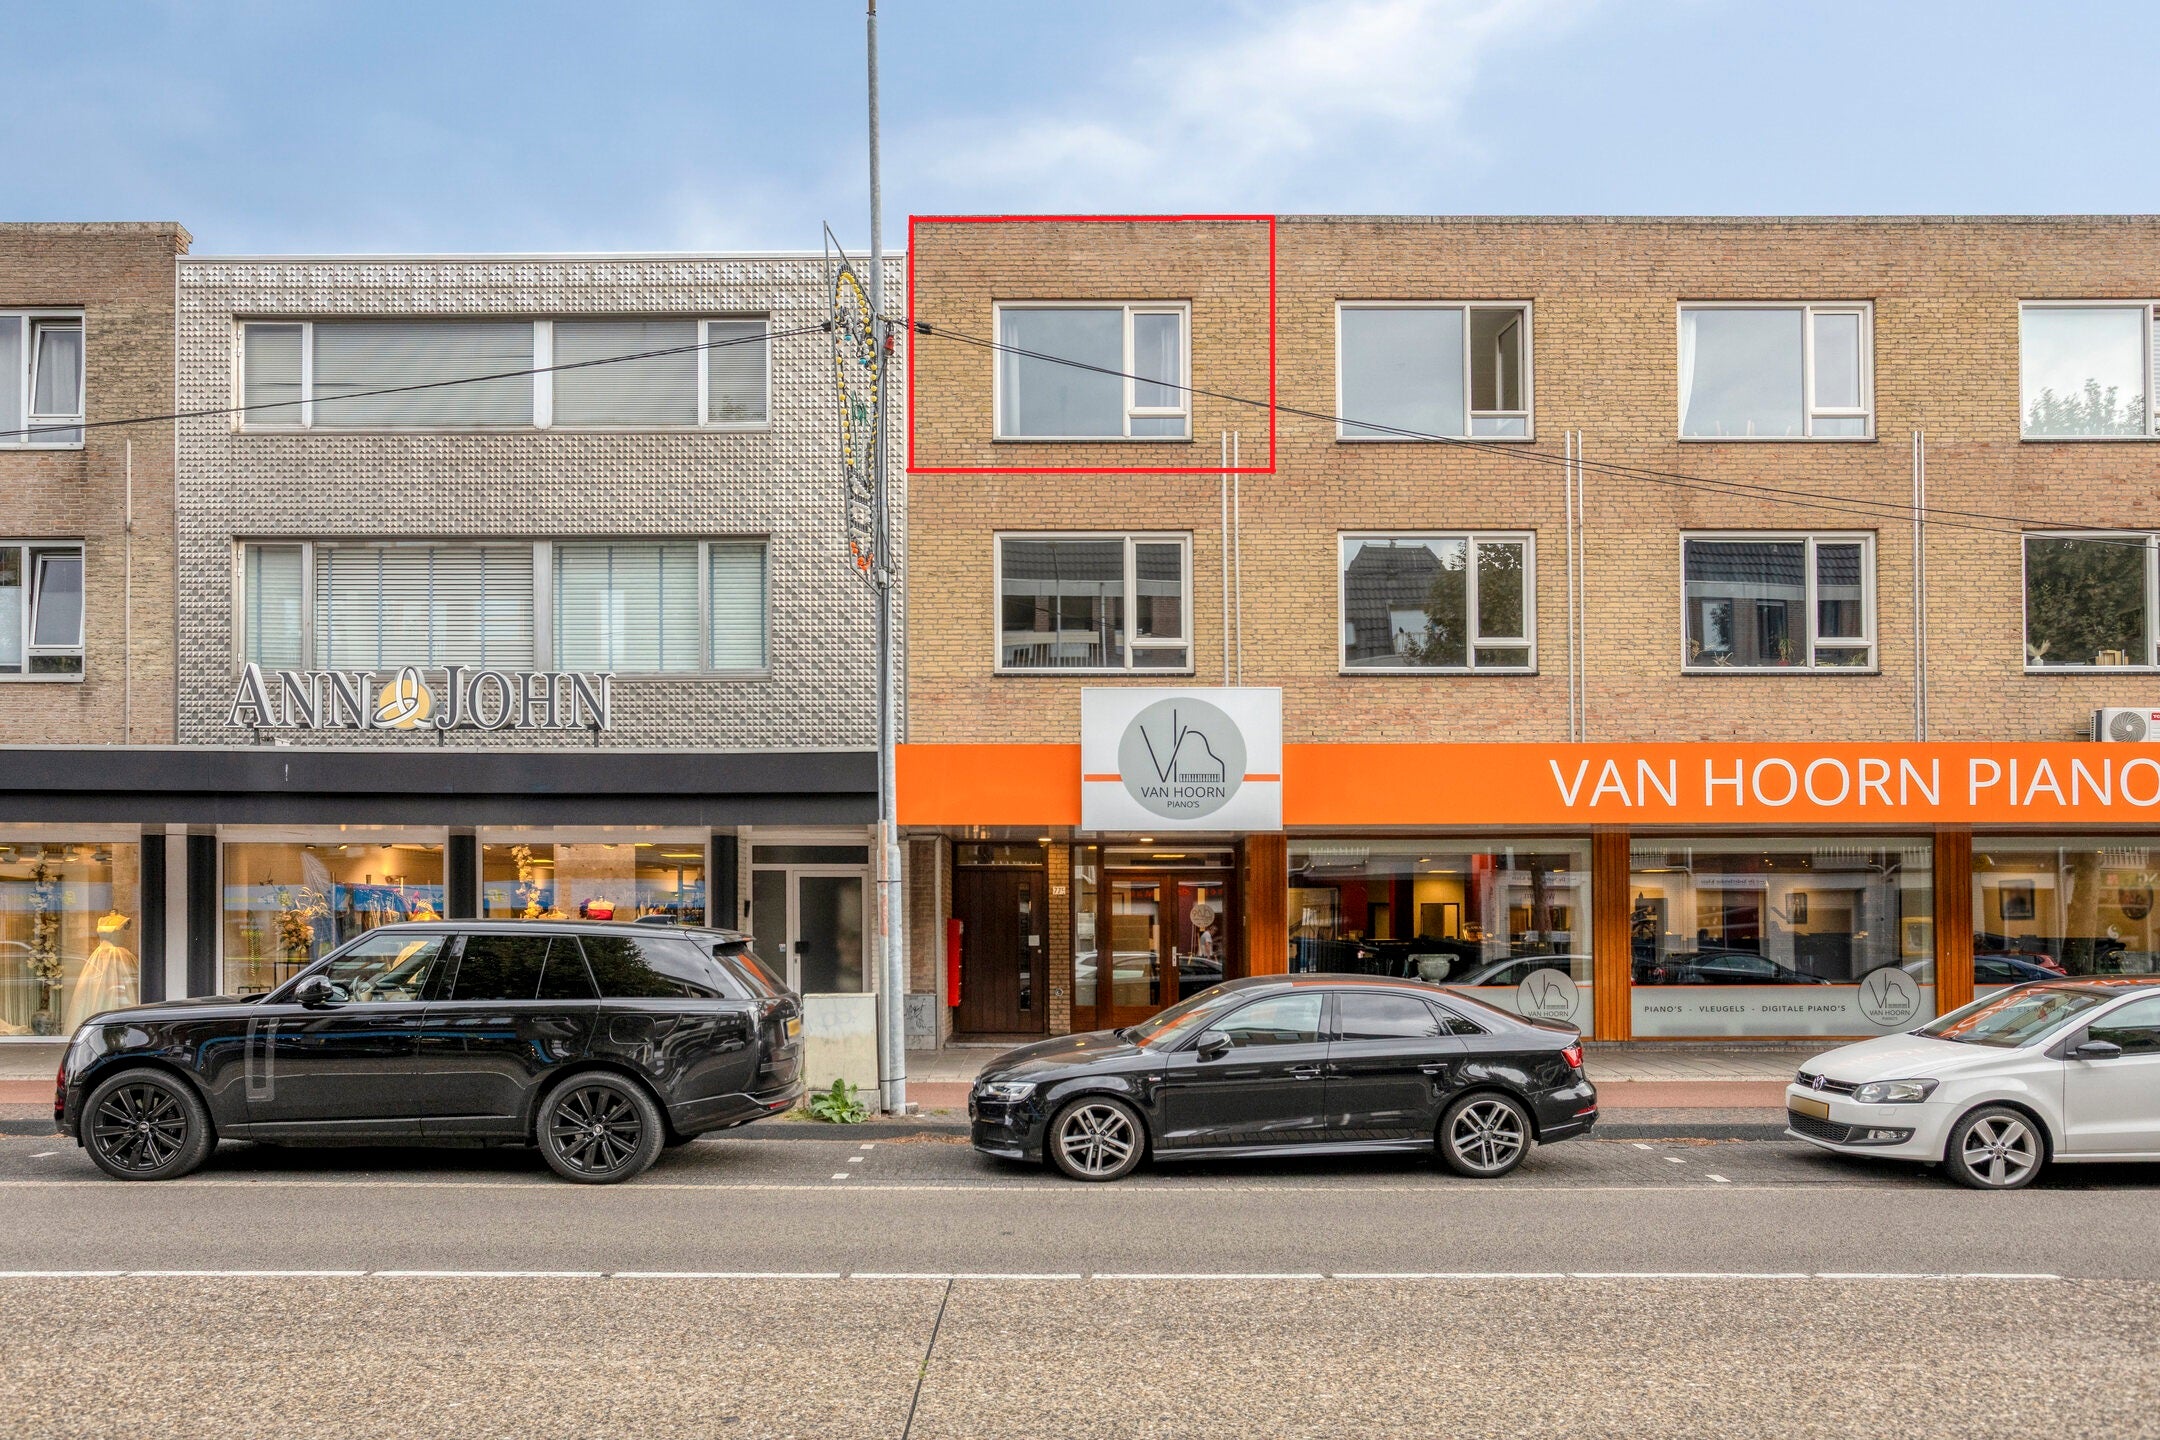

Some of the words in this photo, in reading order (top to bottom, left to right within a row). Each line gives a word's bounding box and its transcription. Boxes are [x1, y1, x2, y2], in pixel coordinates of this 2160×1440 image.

[435, 664, 617, 731] JOHN
[1548, 758, 1677, 807] VAN
[1704, 757, 1940, 807] HOORN
[1968, 757, 2160, 807] PIANO
[1140, 786, 1169, 798] VAN
[1173, 786, 1225, 798] HOORN
[1167, 800, 1200, 808] PIANO'S
[1644, 1005, 1683, 1013] PIANO'S
[1699, 1005, 1745, 1013] VLEUGELS
